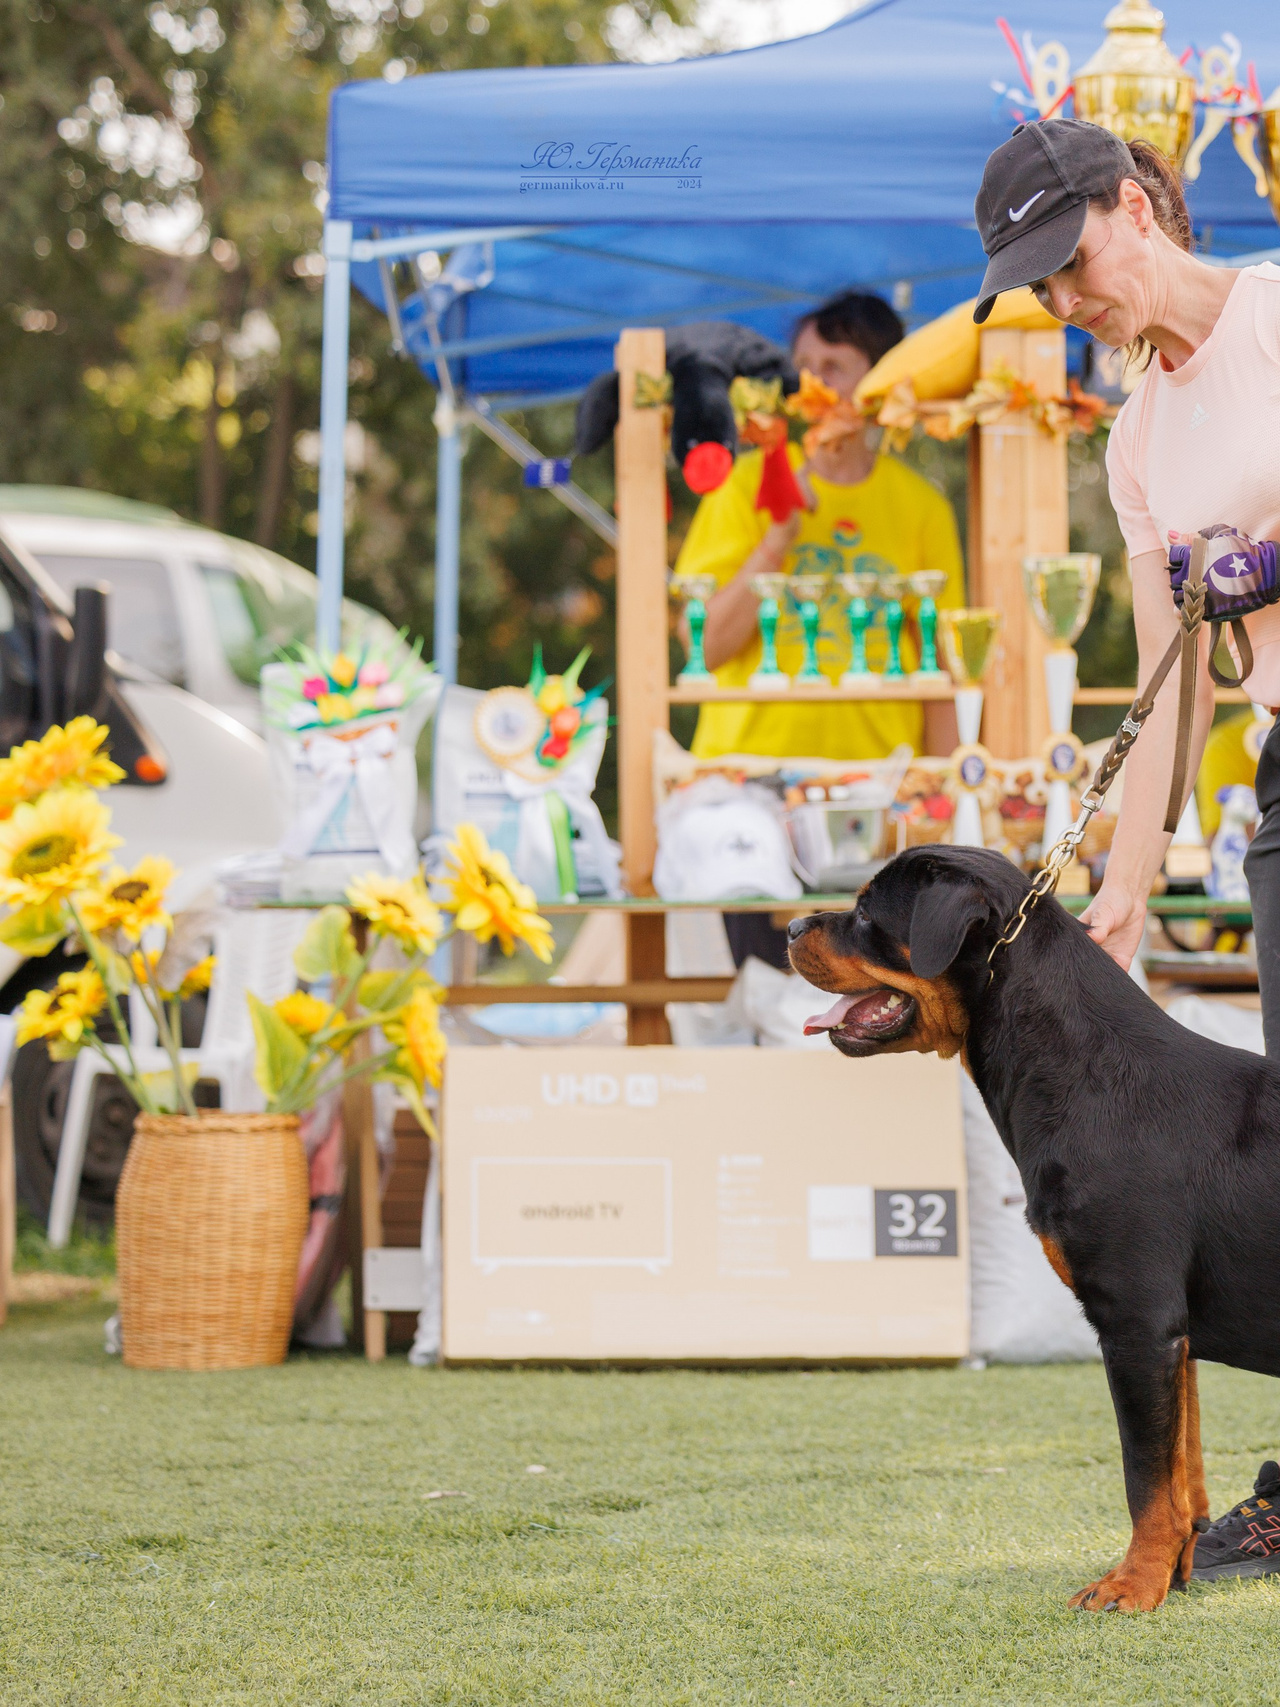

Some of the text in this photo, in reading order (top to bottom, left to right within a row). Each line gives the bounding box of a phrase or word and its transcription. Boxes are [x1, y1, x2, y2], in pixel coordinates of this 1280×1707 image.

[541, 1073, 620, 1106] UHD
[520, 1201, 624, 1220] android TV
[887, 1193, 948, 1238] 32
